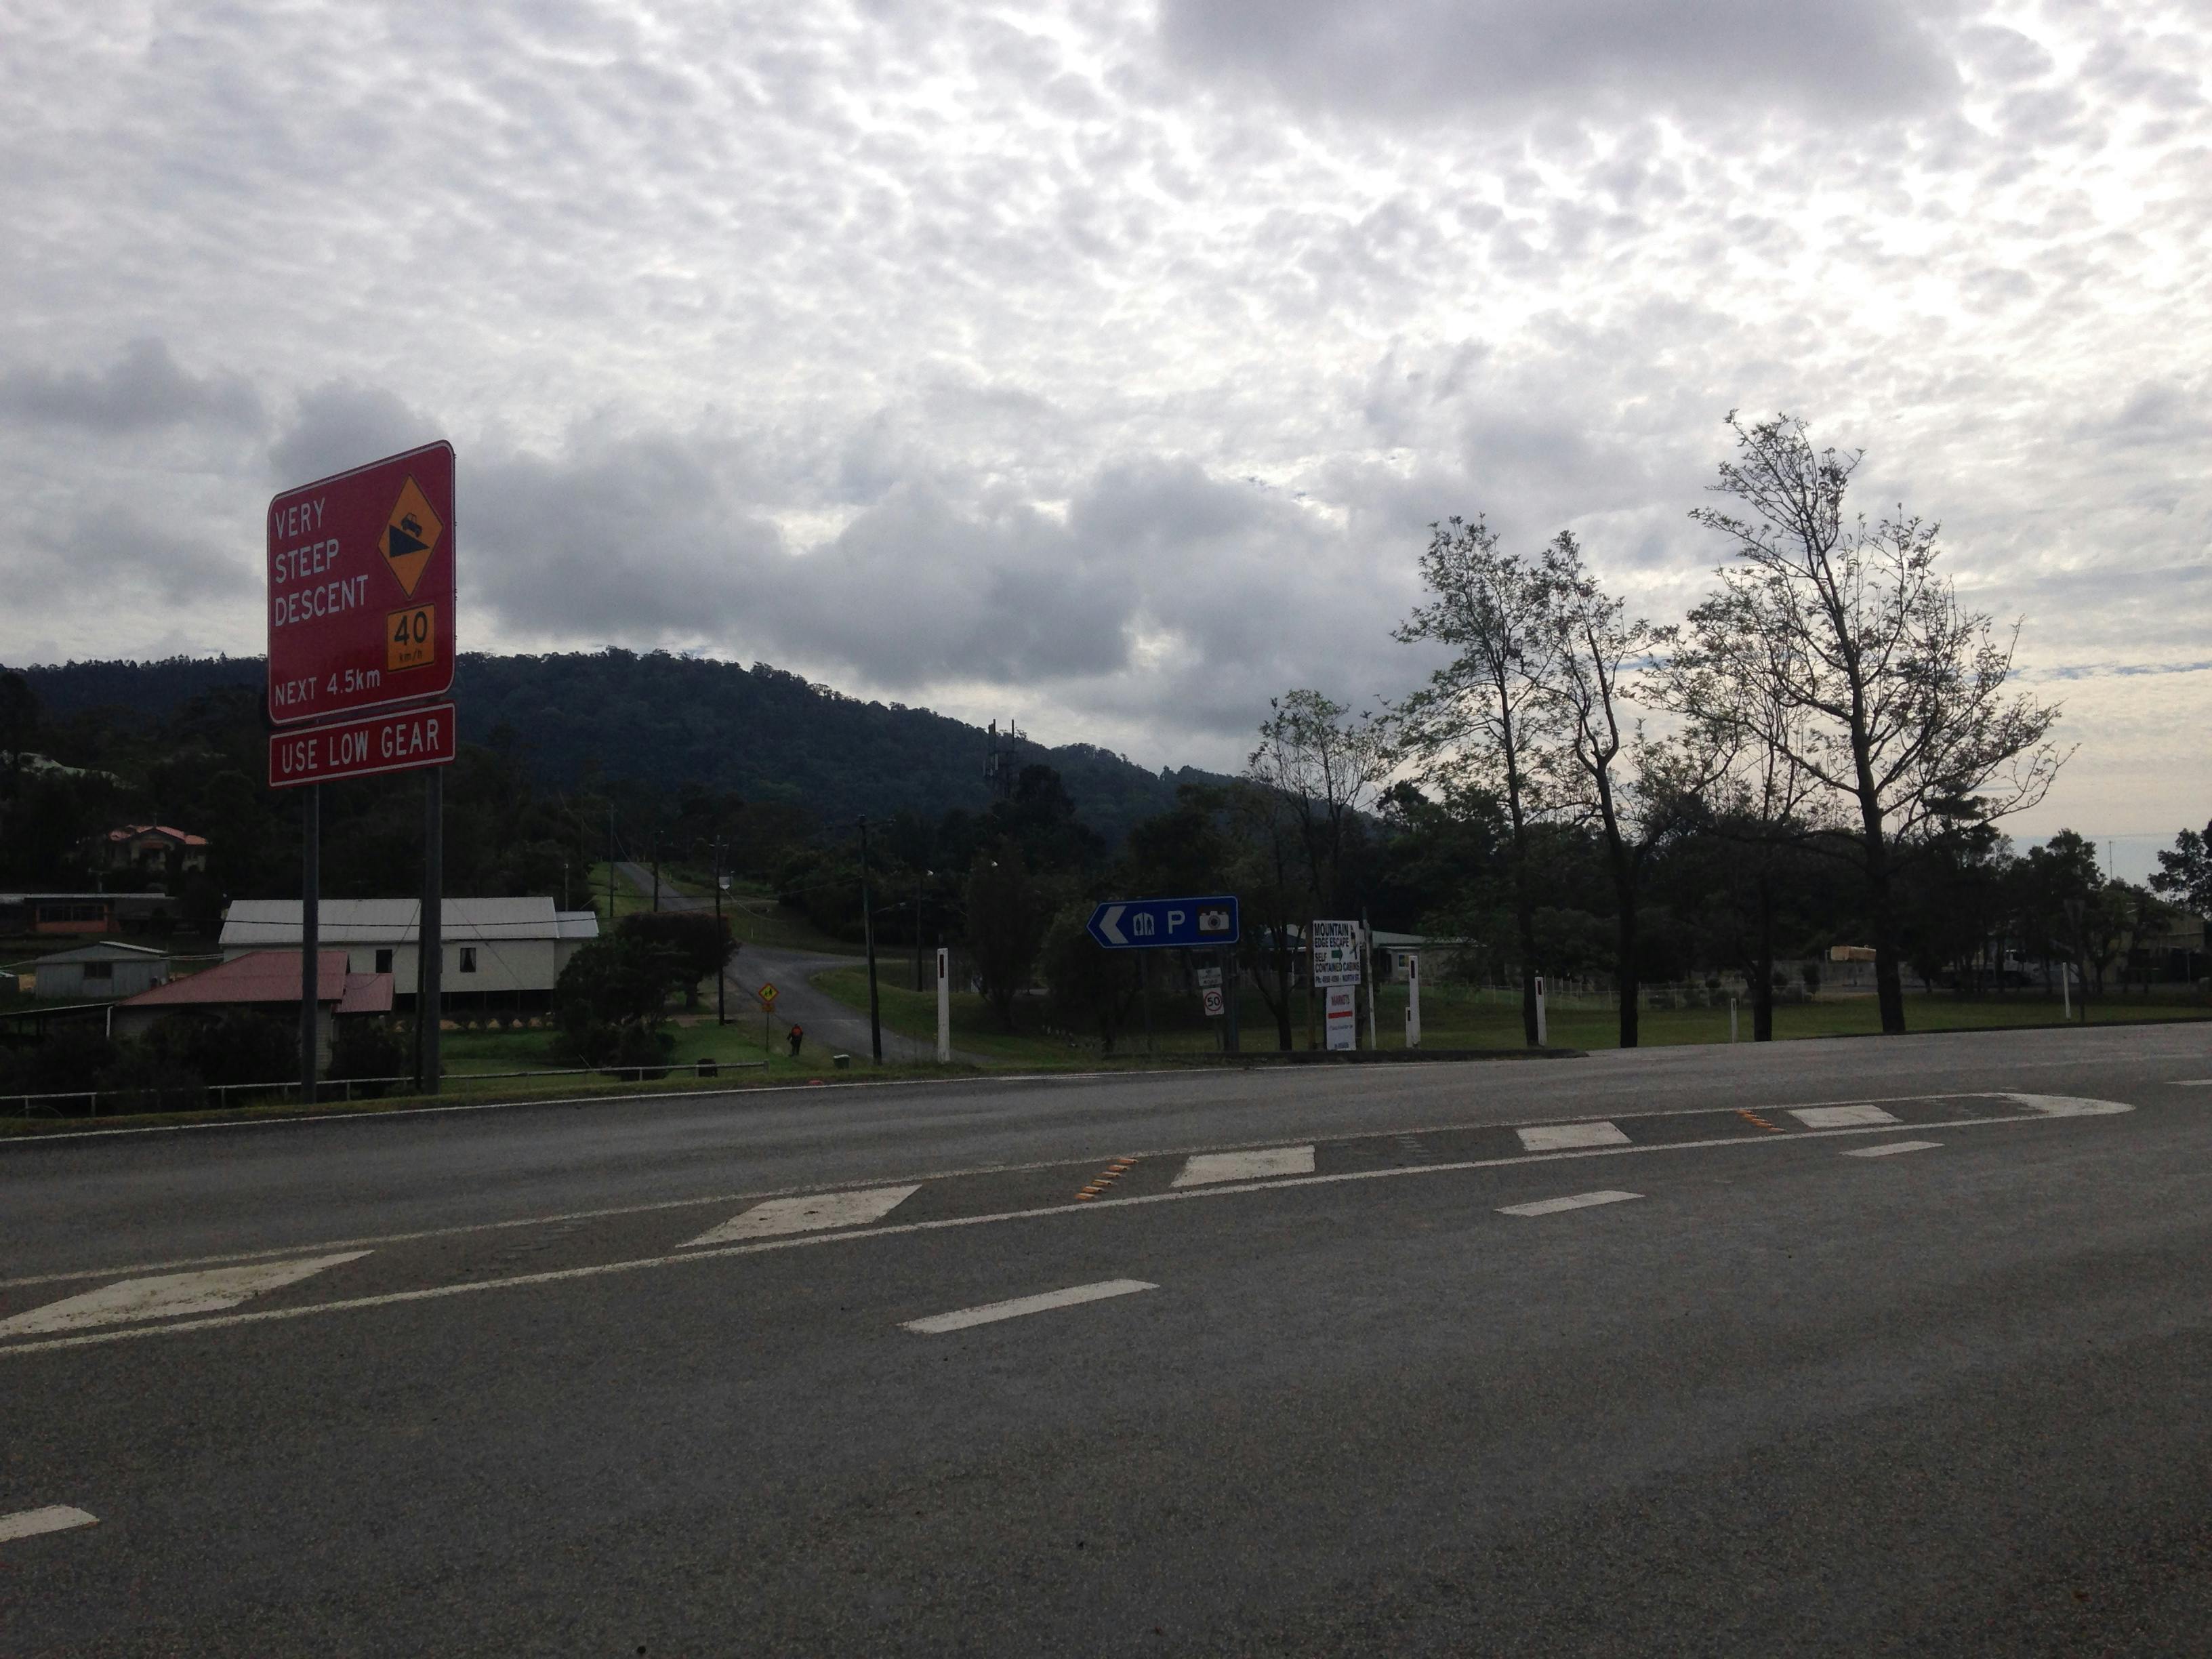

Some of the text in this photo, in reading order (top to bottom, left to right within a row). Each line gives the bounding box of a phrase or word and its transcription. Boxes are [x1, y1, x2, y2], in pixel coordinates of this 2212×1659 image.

[275, 497, 325, 539] VERY
[275, 539, 338, 583] STEEP
[275, 575, 368, 626] DESCENT
[394, 611, 428, 645] 40
[399, 649, 423, 662] km/h
[275, 669, 380, 706] NEXT 4.5km
[282, 718, 439, 773] USE LOW GEAR
[1167, 910, 1185, 934] P
[1314, 923, 1349, 937] MOUNTAIN
[1315, 937, 1349, 947] EDGE ESCAPE
[1315, 952, 1327, 962] SELF
[1315, 962, 1359, 972] CONTAINED CABINS
[1207, 996, 1220, 1006] 50
[1332, 994, 1350, 1006] MARKETS
